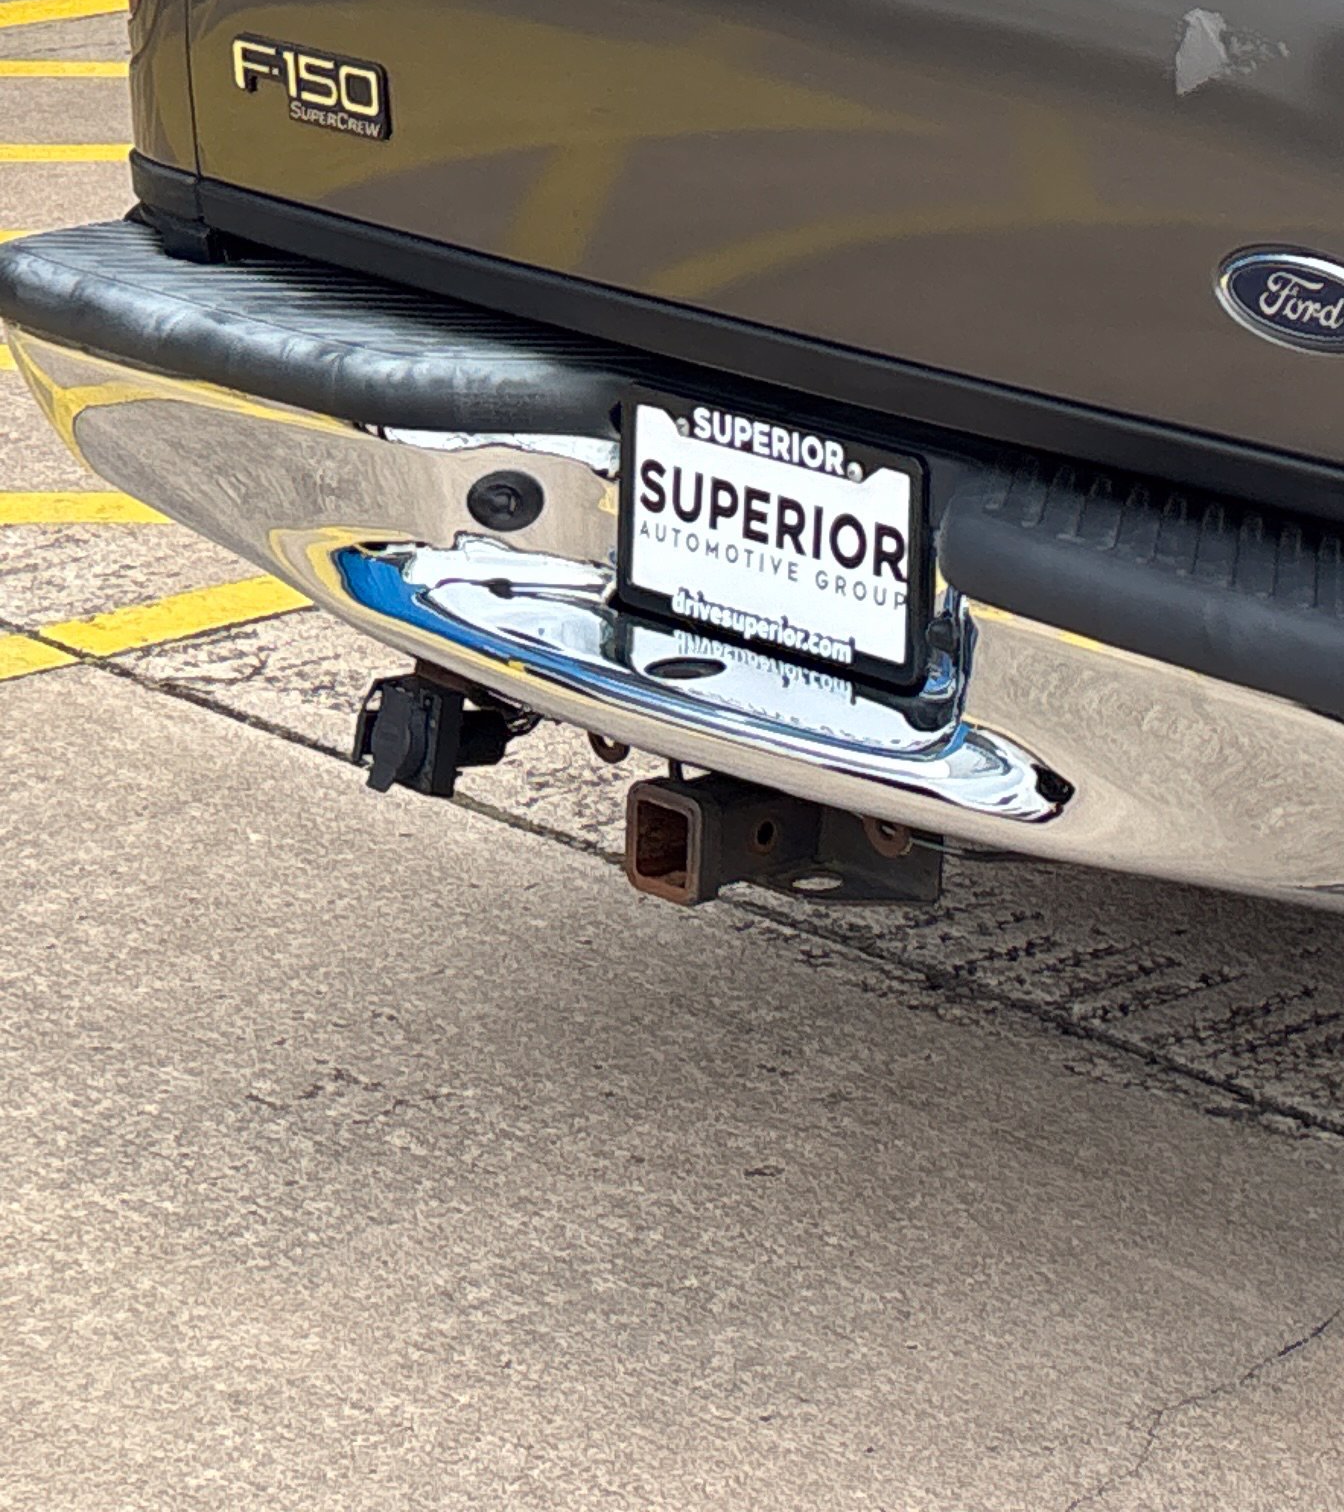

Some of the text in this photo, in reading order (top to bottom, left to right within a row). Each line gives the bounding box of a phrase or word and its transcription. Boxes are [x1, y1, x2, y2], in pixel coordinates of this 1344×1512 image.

[1259, 271, 1344, 329] Ford
[693, 406, 845, 476] SUPERIOR
[640, 458, 907, 583] SUPERIOR
[640, 520, 906, 611] AUTOMOTIVE GROUP
[671, 586, 855, 665] drivesuperior.com
